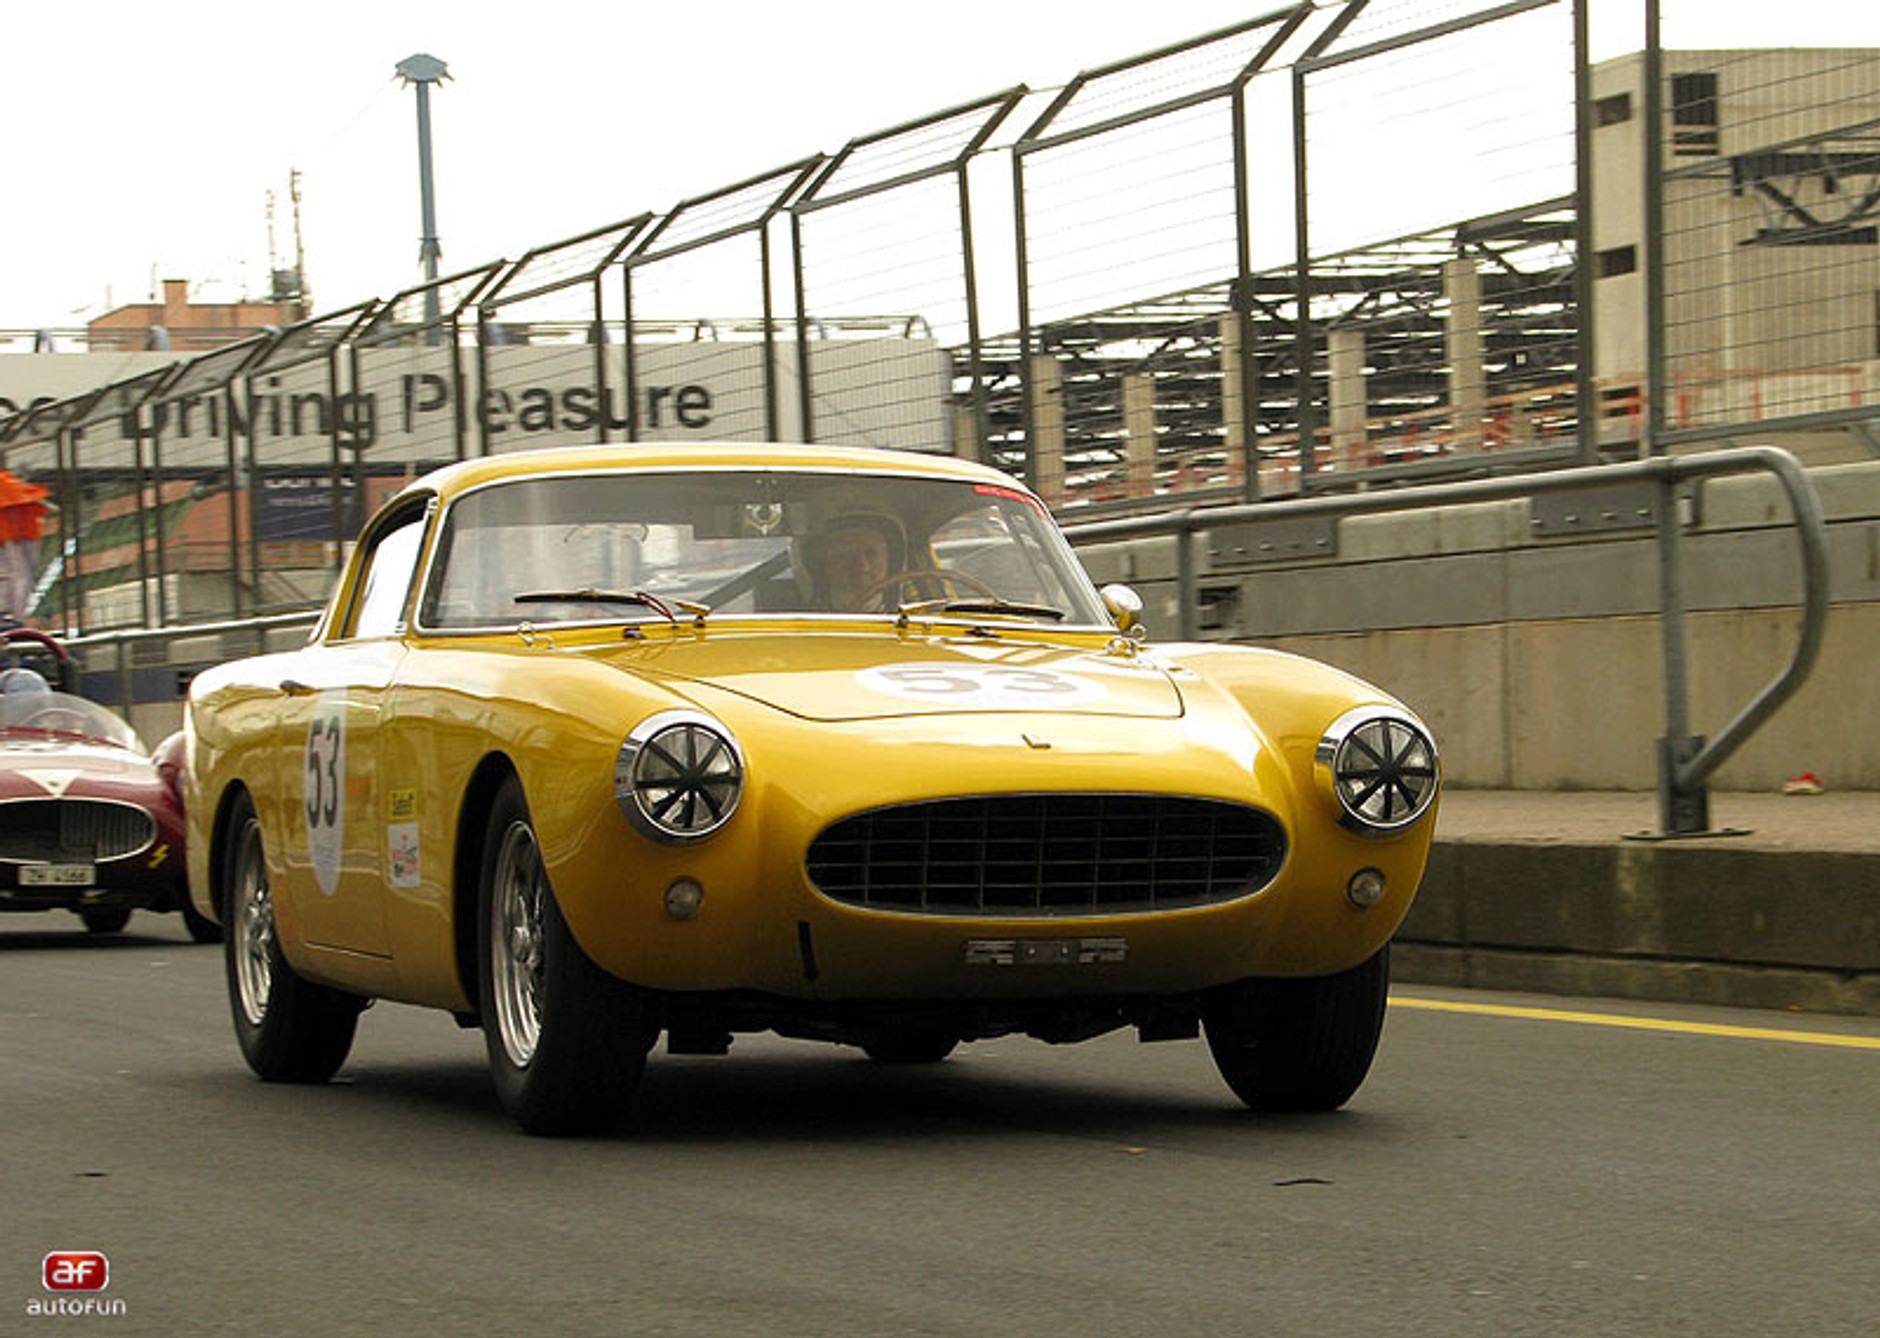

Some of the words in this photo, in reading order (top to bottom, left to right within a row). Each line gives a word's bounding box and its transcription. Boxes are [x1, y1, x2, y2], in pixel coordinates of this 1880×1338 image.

[402, 373, 712, 433] Pleasure
[878, 668, 1078, 693] 53
[308, 716, 339, 829] 53
